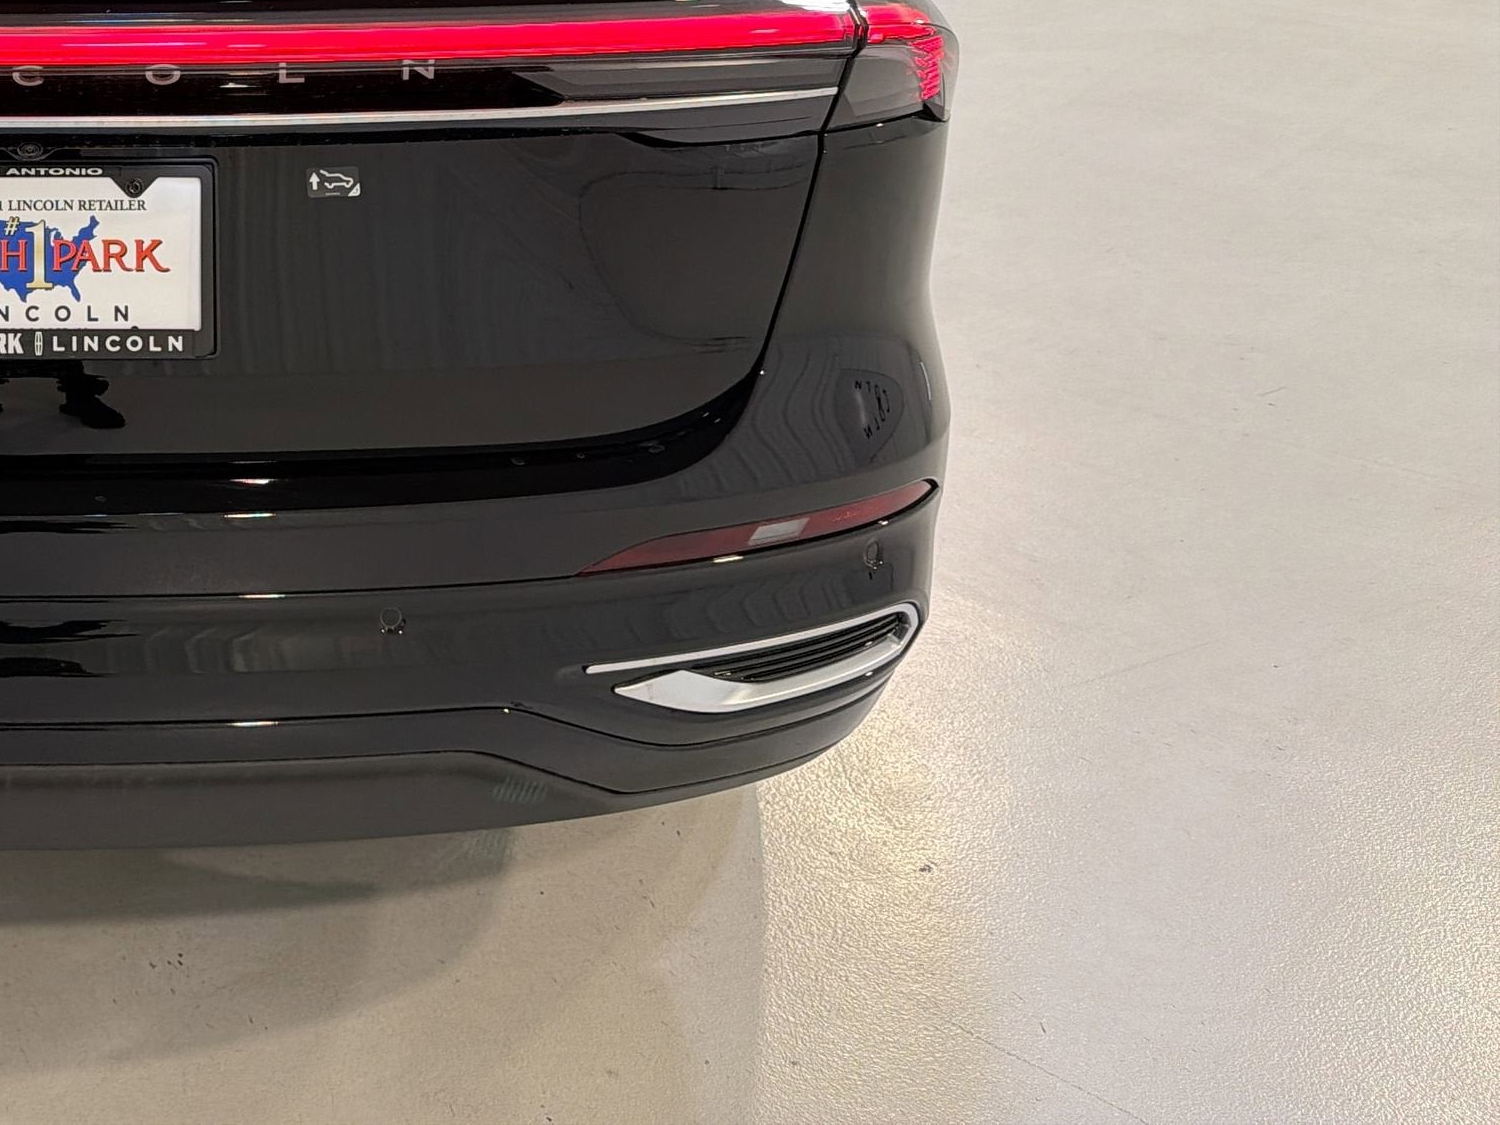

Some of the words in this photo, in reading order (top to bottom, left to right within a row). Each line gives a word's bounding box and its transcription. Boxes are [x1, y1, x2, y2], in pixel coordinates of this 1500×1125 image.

[5, 167, 103, 176] ANTONIO
[7, 199, 74, 212] LINCOLN
[78, 199, 147, 212] RETAILER
[52, 239, 171, 273] PARK
[52, 336, 184, 352] LINCOLN
